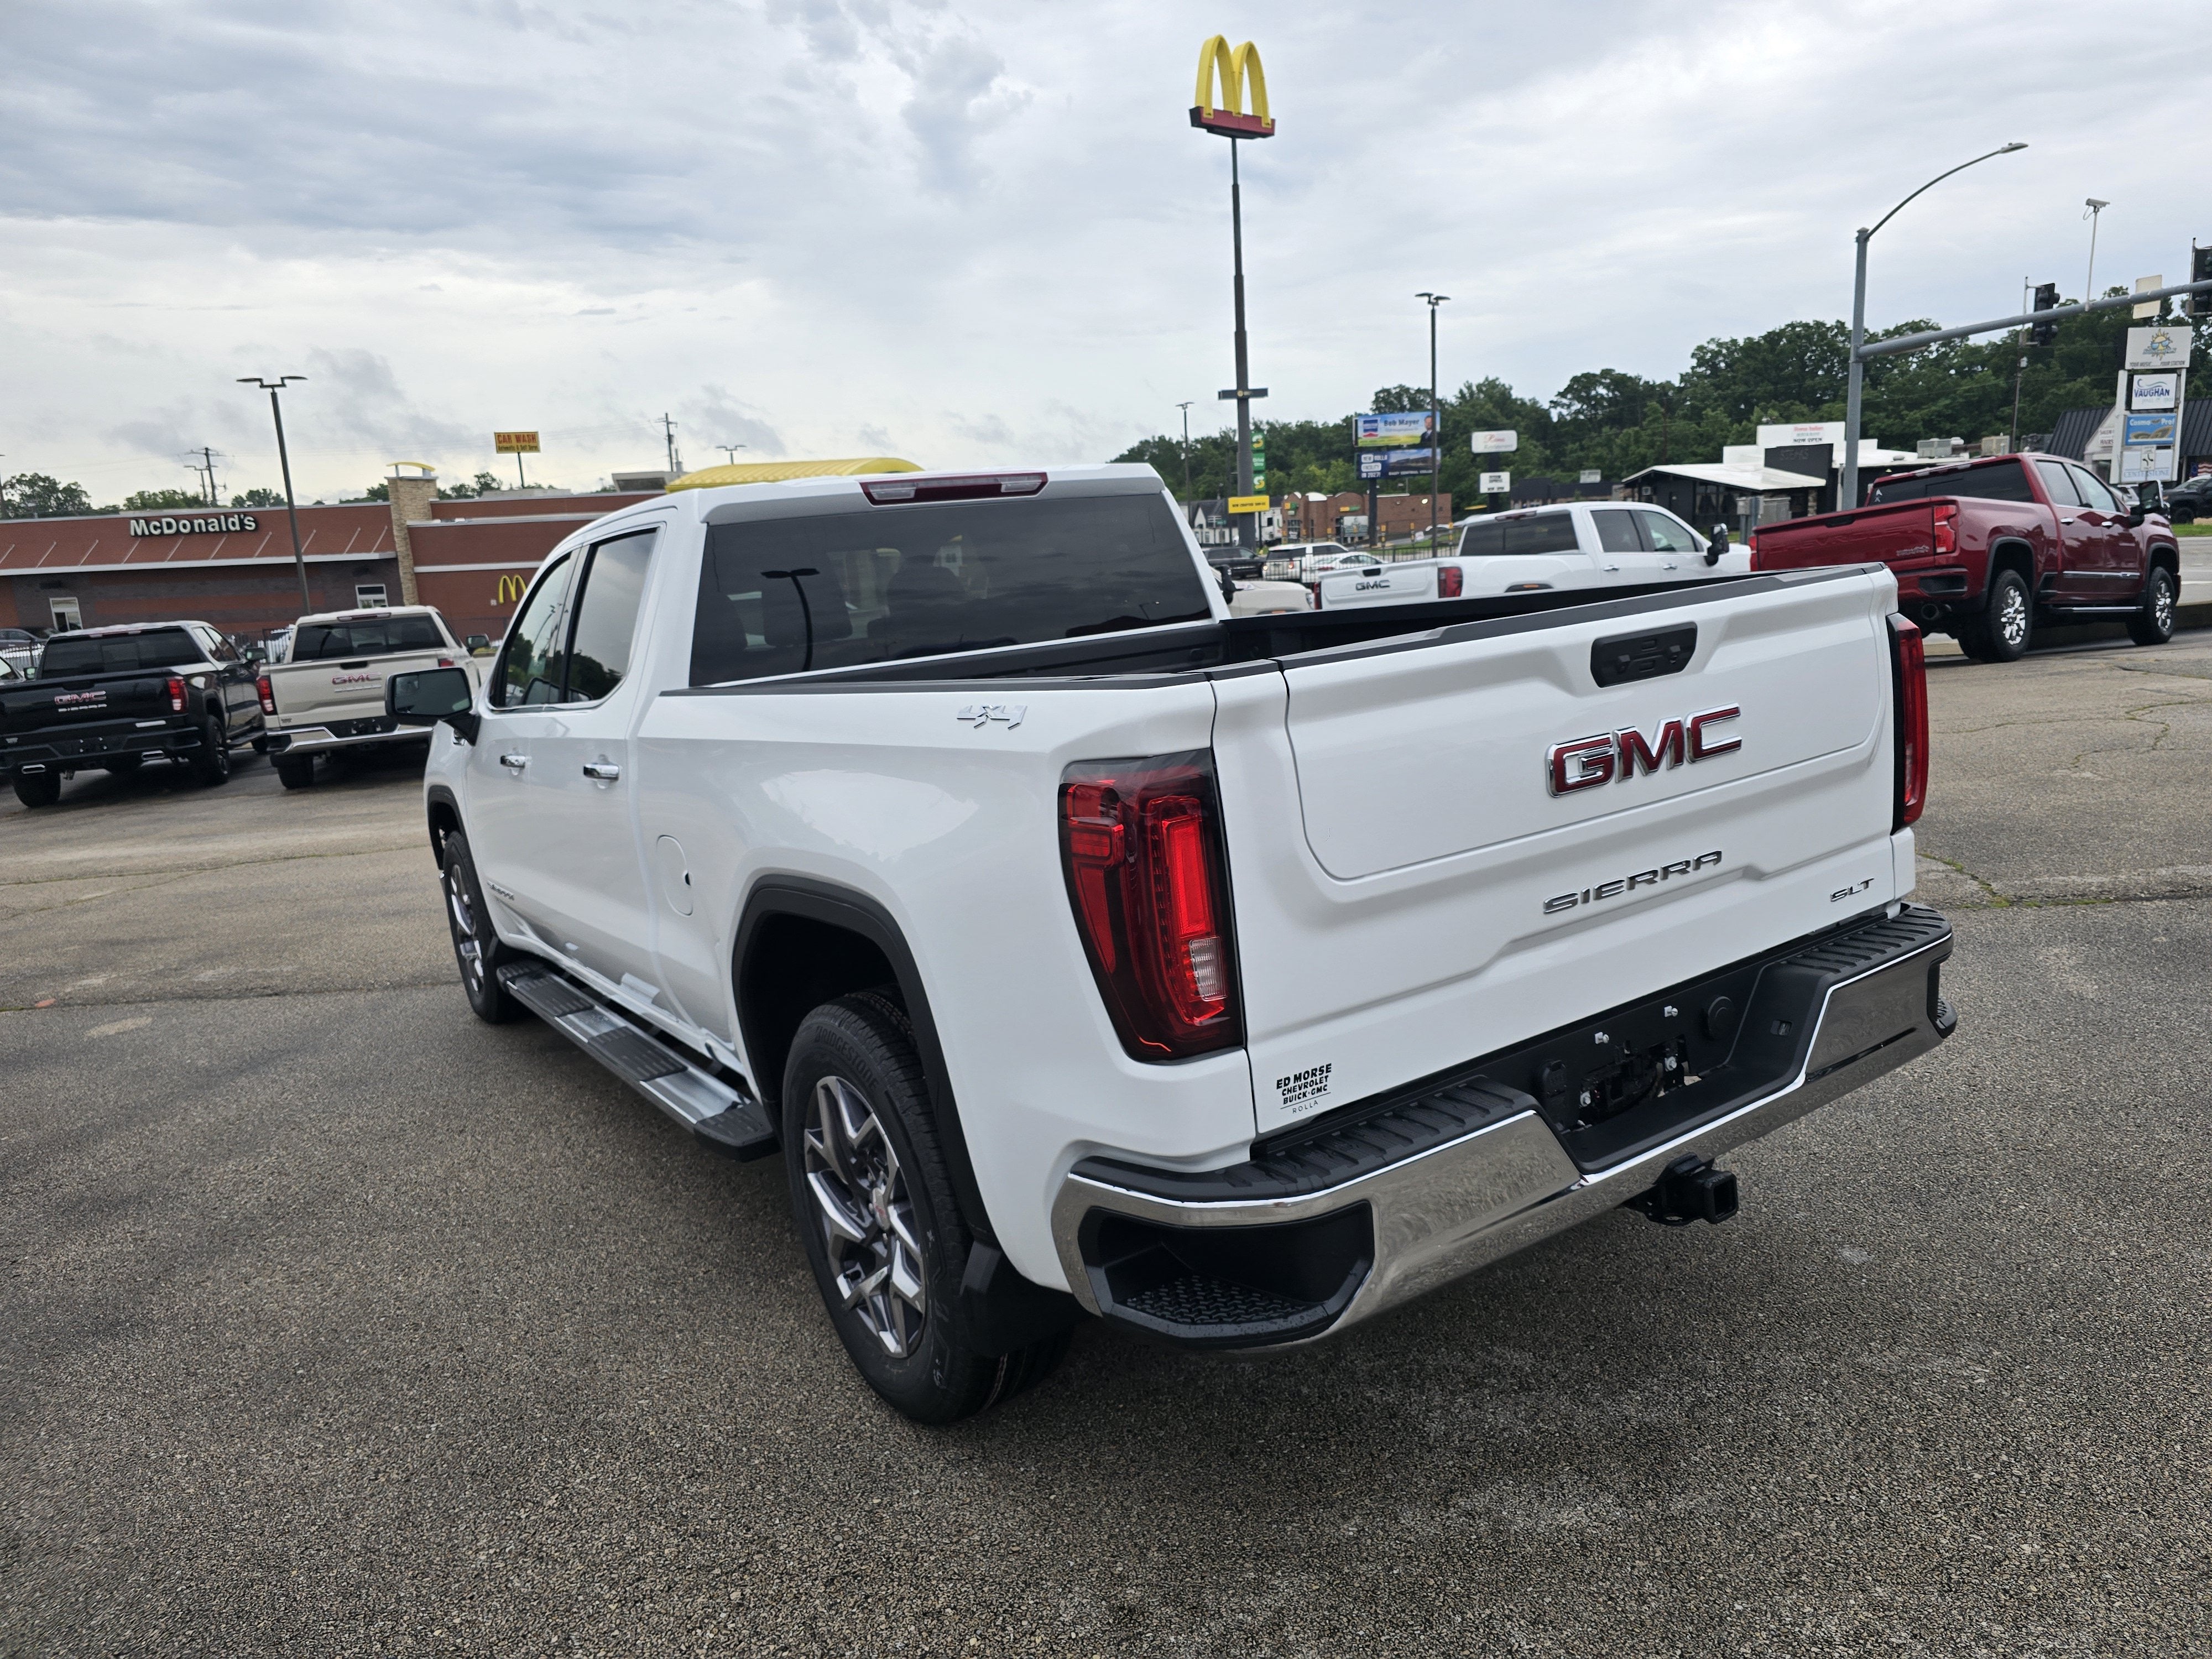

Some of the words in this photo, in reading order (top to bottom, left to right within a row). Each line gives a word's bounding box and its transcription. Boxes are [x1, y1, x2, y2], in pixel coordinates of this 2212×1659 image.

[2133, 388, 2170, 398] VAUGHAN
[1398, 419, 1420, 427] Mayer
[2129, 418, 2151, 426] Cosmo
[497, 434, 513, 445] CAR
[514, 433, 537, 444] WASH
[129, 513, 257, 537] McDonald's
[1355, 579, 1391, 591] GMC
[332, 672, 382, 685] GMC
[54, 690, 107, 705] GMC
[1545, 702, 1743, 799] GMC
[1543, 849, 1723, 914] SIERRA
[1830, 877, 1875, 902] SLT
[1276, 1076, 1291, 1090] ED
[1293, 1062, 1332, 1084] MORSE
[1281, 1074, 1329, 1097] CHEVROLET
[1292, 1099, 1319, 1114] ROLLA
